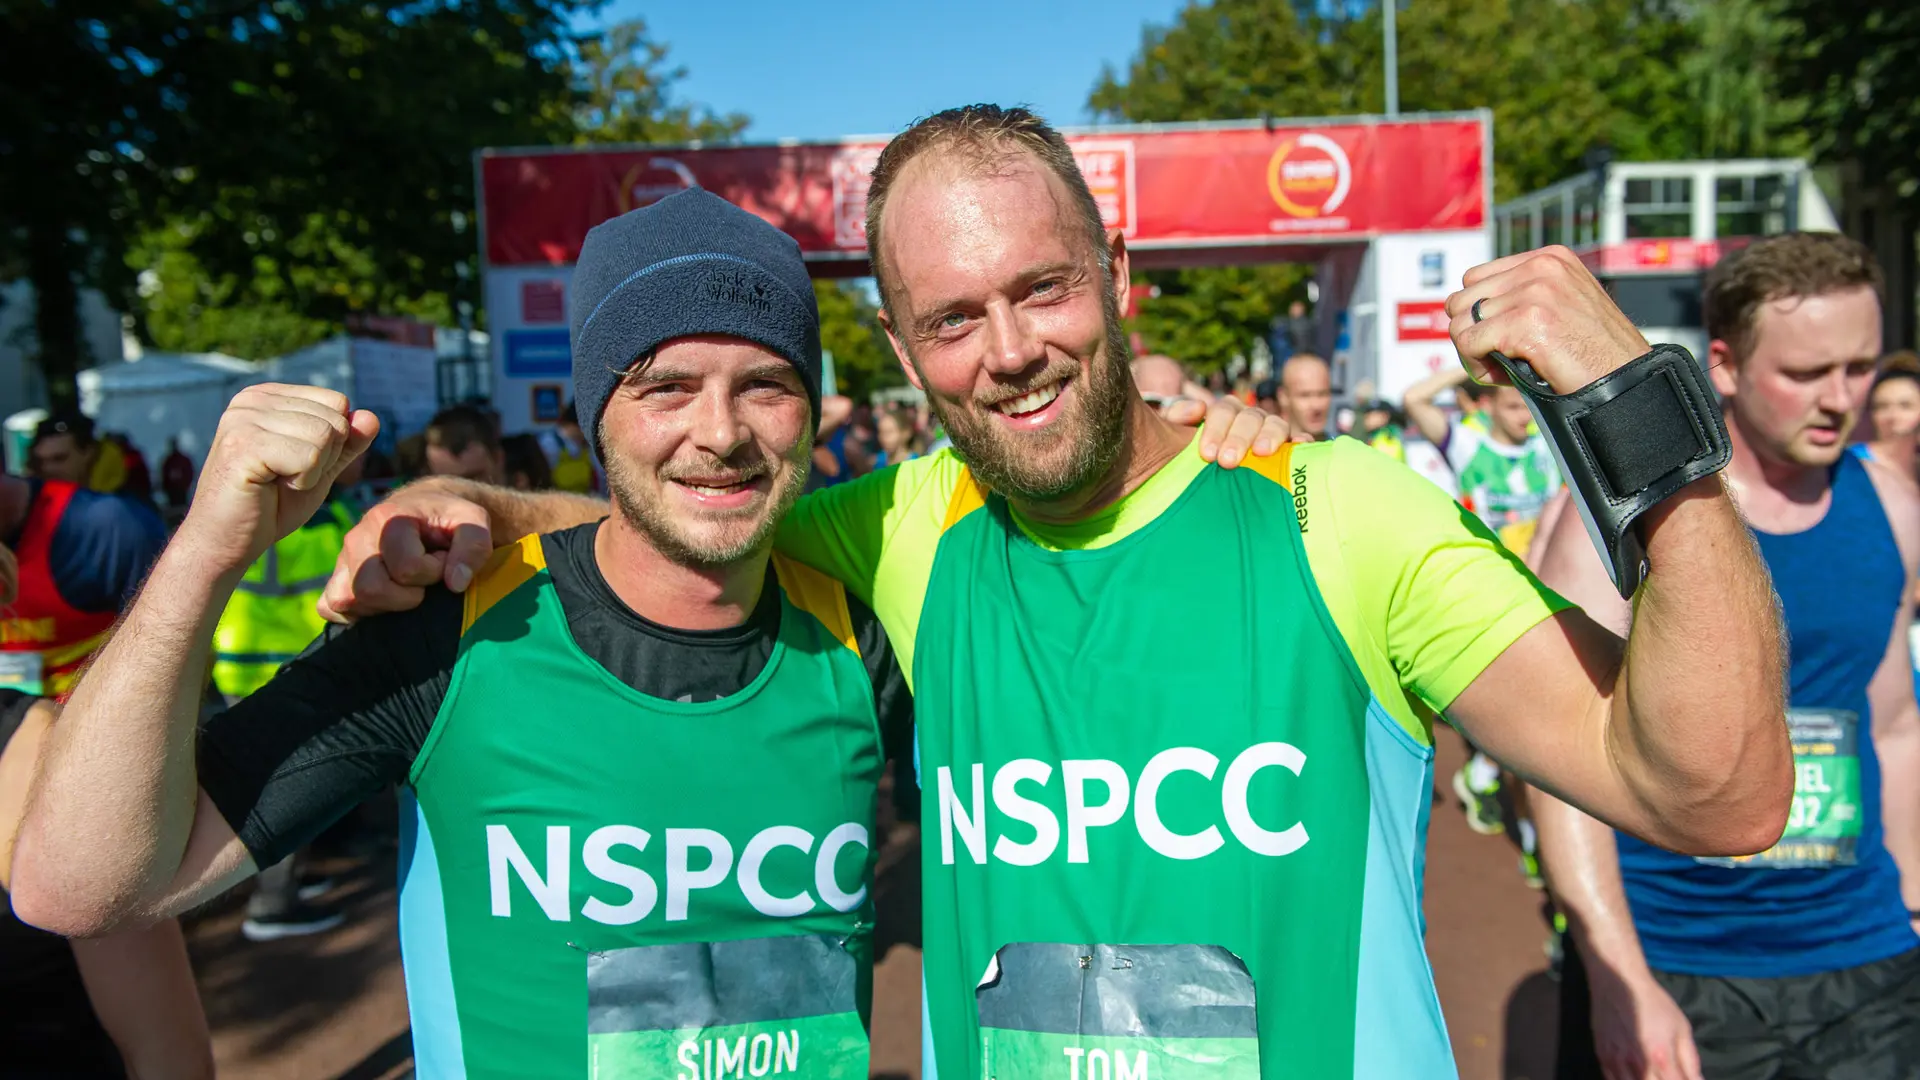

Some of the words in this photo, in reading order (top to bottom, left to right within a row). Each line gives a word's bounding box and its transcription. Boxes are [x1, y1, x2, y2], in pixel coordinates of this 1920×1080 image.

[706, 264, 745, 288] Jack
[703, 282, 772, 313] Wolfskin
[936, 741, 1311, 867] NSPCC
[485, 821, 870, 926] NSPCC
[677, 1029, 799, 1080] SIMON
[1063, 1047, 1149, 1080] TOM
